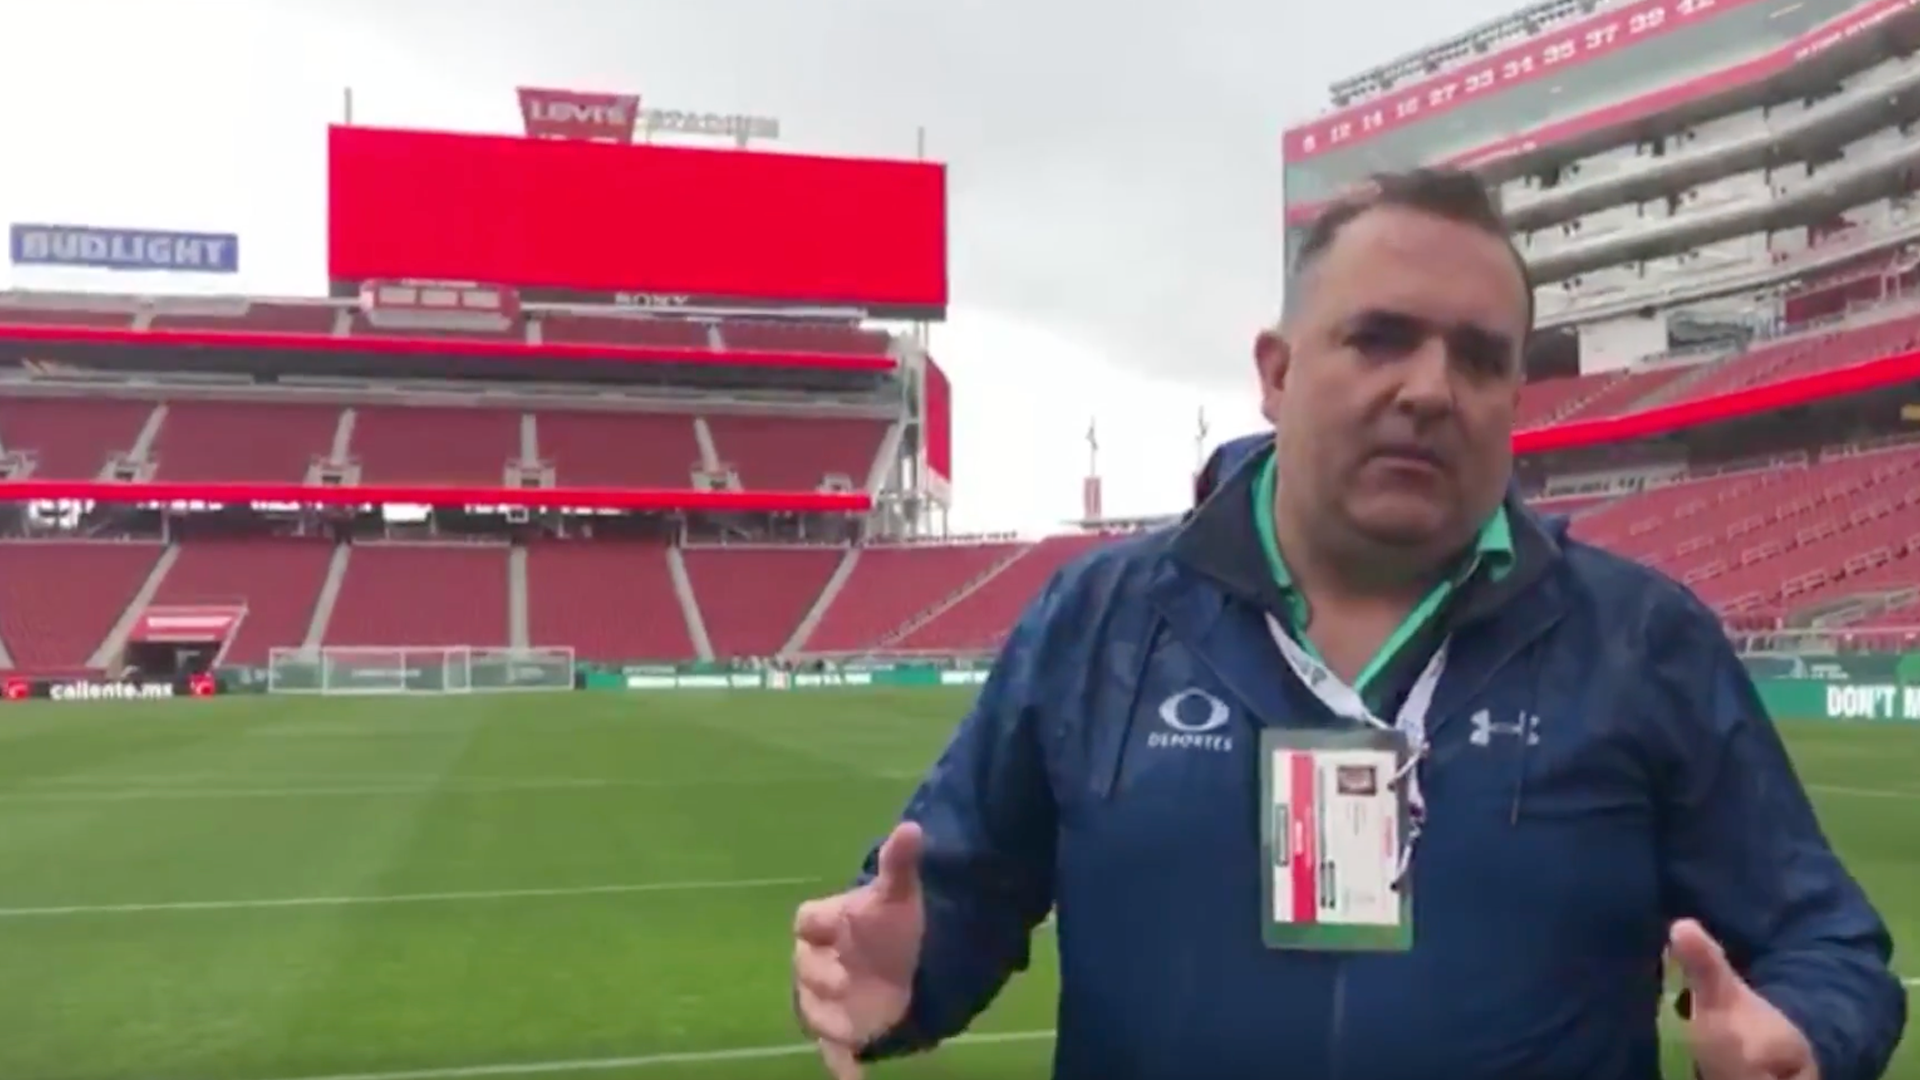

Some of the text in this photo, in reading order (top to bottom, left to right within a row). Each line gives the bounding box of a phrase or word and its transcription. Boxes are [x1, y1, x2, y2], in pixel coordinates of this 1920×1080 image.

[1330, 123, 1351, 143] 12
[1362, 110, 1383, 131] 14
[1503, 56, 1534, 79] 34
[1585, 23, 1619, 49] 37
[1827, 684, 1897, 719] DON'T
[1147, 732, 1233, 752] DEPORTES
